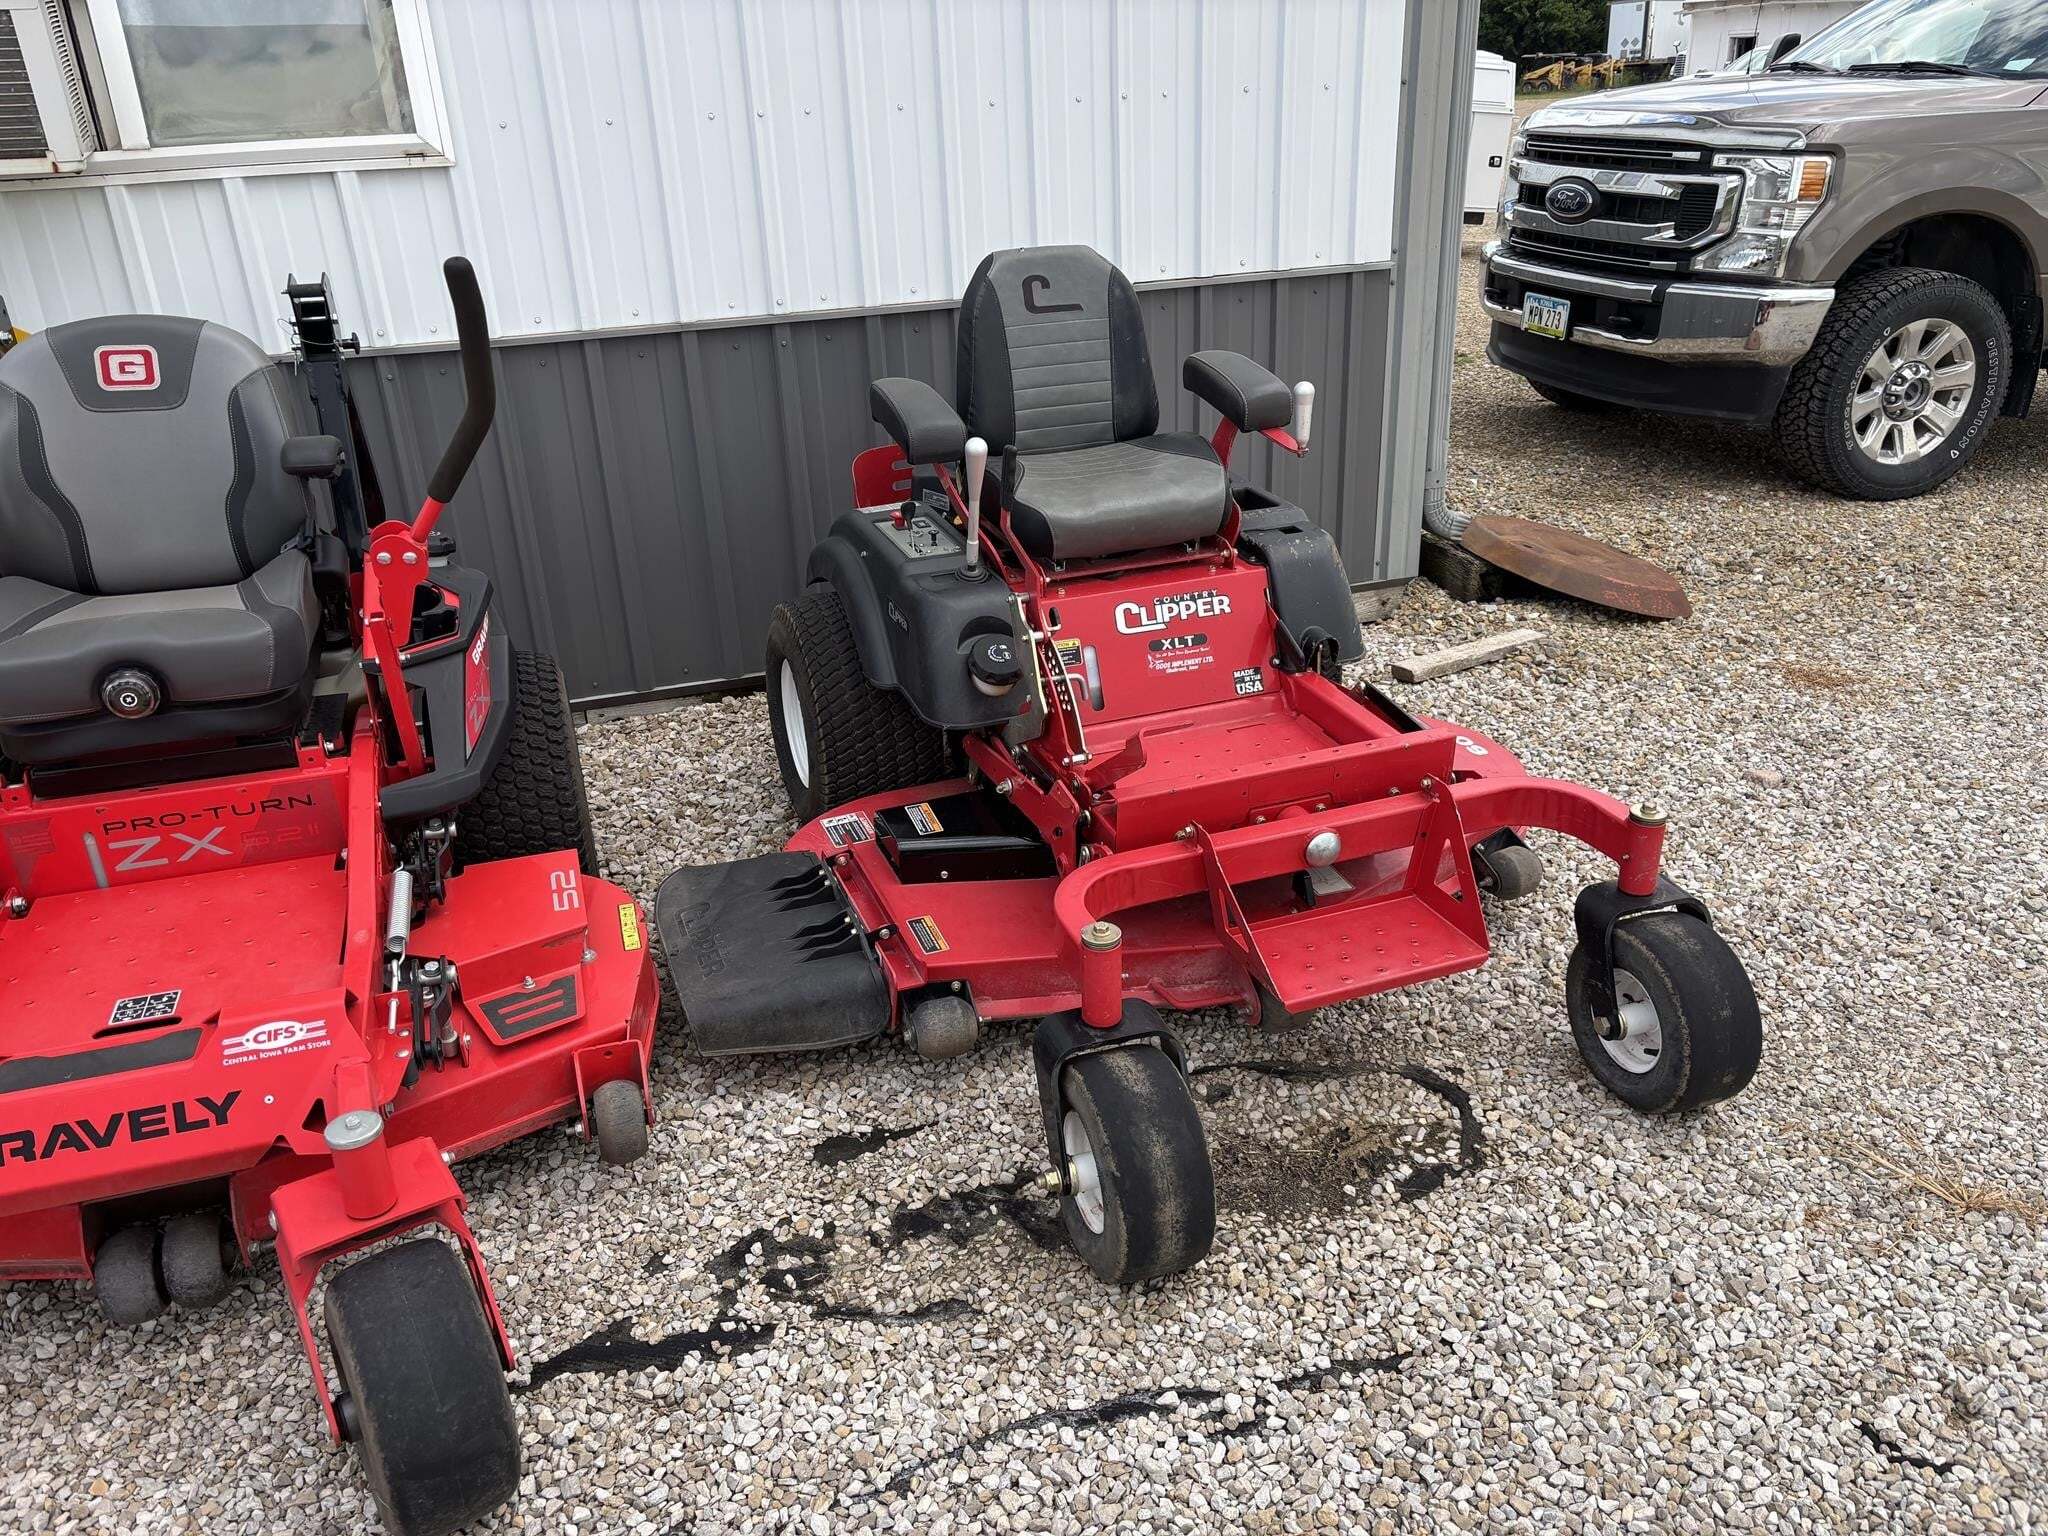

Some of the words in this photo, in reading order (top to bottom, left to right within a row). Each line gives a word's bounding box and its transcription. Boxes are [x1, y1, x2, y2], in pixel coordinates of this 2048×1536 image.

[1554, 190, 1580, 210] Ford
[1545, 309, 1562, 330] 273
[1958, 338, 1999, 449] DESTINATION
[1153, 589, 1218, 604] COUNTRY
[1114, 595, 1232, 634] CLIPPER
[1161, 635, 1195, 650] XLT
[1233, 668, 1255, 678] MADE
[1236, 681, 1264, 695] USA
[102, 793, 313, 836] PRO-TURN
[108, 826, 233, 872] ZX
[550, 869, 580, 911] 52
[252, 1025, 297, 1045] CIFS
[222, 1054, 258, 1066] CENTRAL
[259, 1048, 282, 1059] IOWA
[283, 1043, 306, 1055] FARM
[307, 1039, 331, 1050] STORE
[0, 1090, 243, 1168] RAVELY
